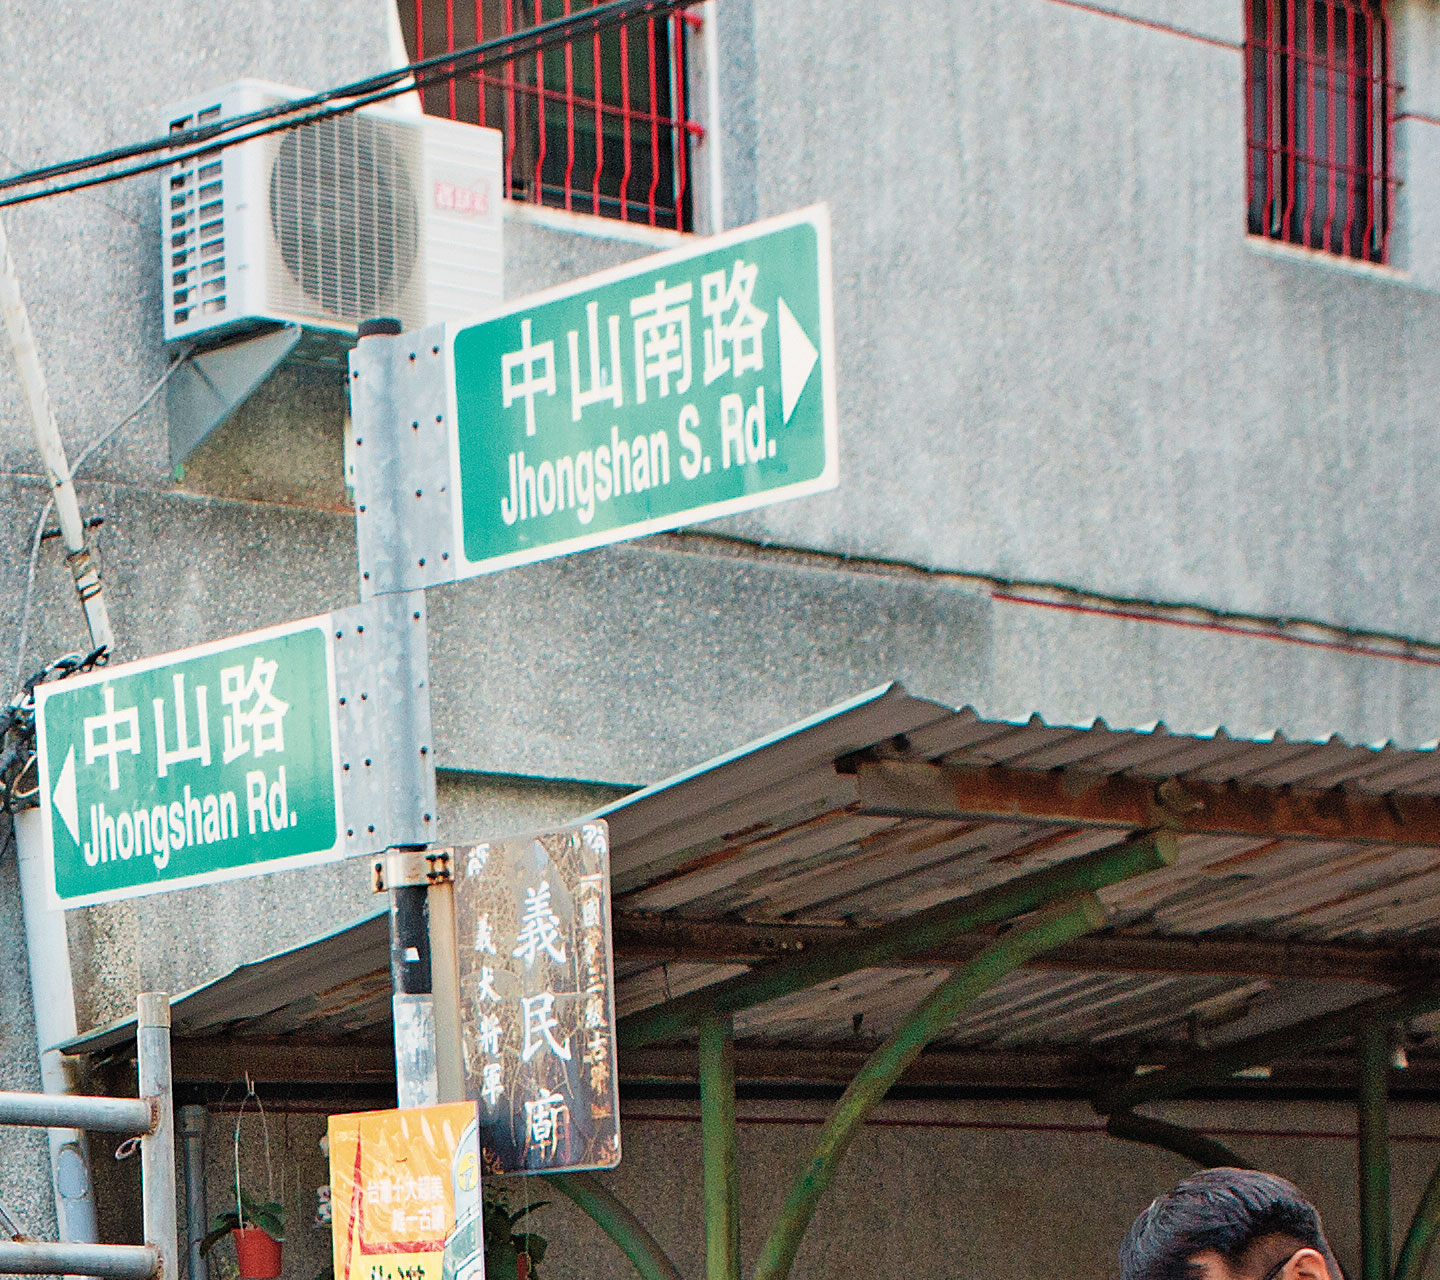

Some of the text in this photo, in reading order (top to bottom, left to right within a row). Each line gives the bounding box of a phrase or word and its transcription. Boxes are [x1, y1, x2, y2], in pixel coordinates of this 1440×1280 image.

[498, 257, 770, 440] 中山南路
[500, 397, 777, 528] Jhongshan S. Rd.
[82, 656, 288, 795] 中山路
[83, 769, 298, 867] Jhongshan Rd.
[512, 880, 572, 1163] 義民廟
